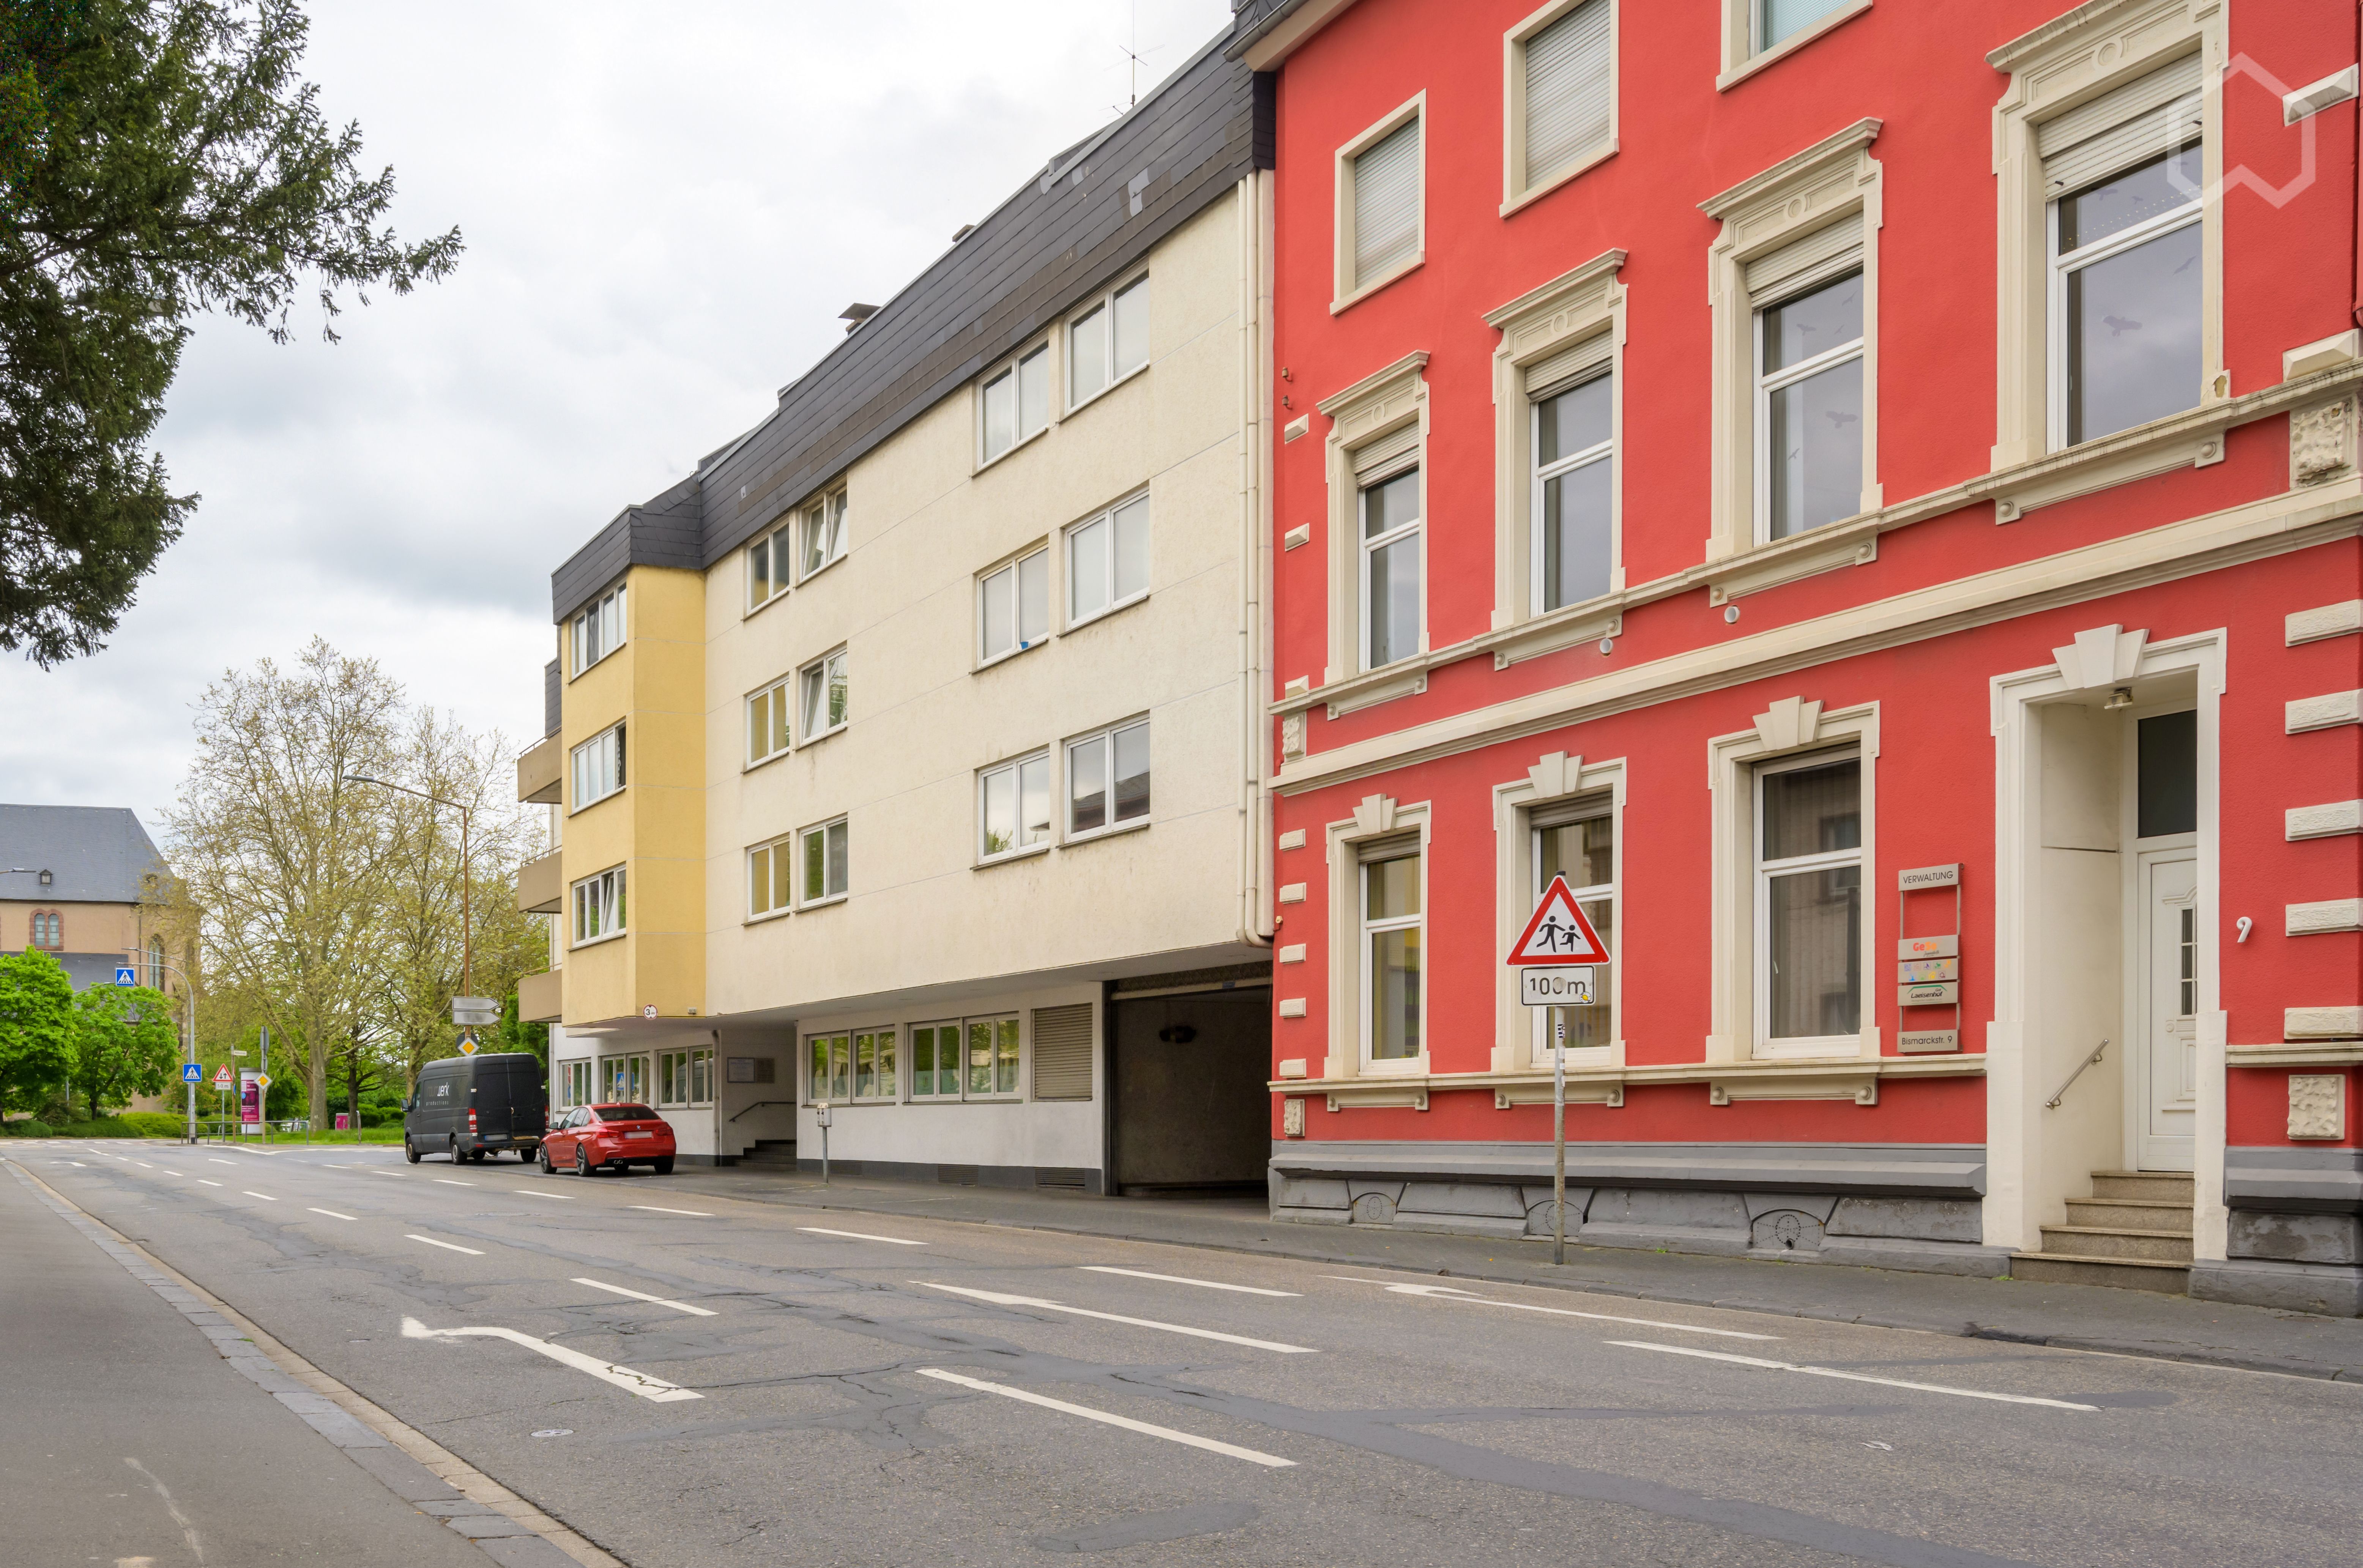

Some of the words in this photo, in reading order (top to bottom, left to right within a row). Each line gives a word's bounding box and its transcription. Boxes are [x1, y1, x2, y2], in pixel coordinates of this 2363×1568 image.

[1903, 871, 1953, 884] VERWALTUNG
[2236, 916, 2252, 943] 9
[1913, 941, 1937, 951] GeSo
[1568, 981, 1585, 994] m
[1902, 1036, 1944, 1045] Bismarckstr.
